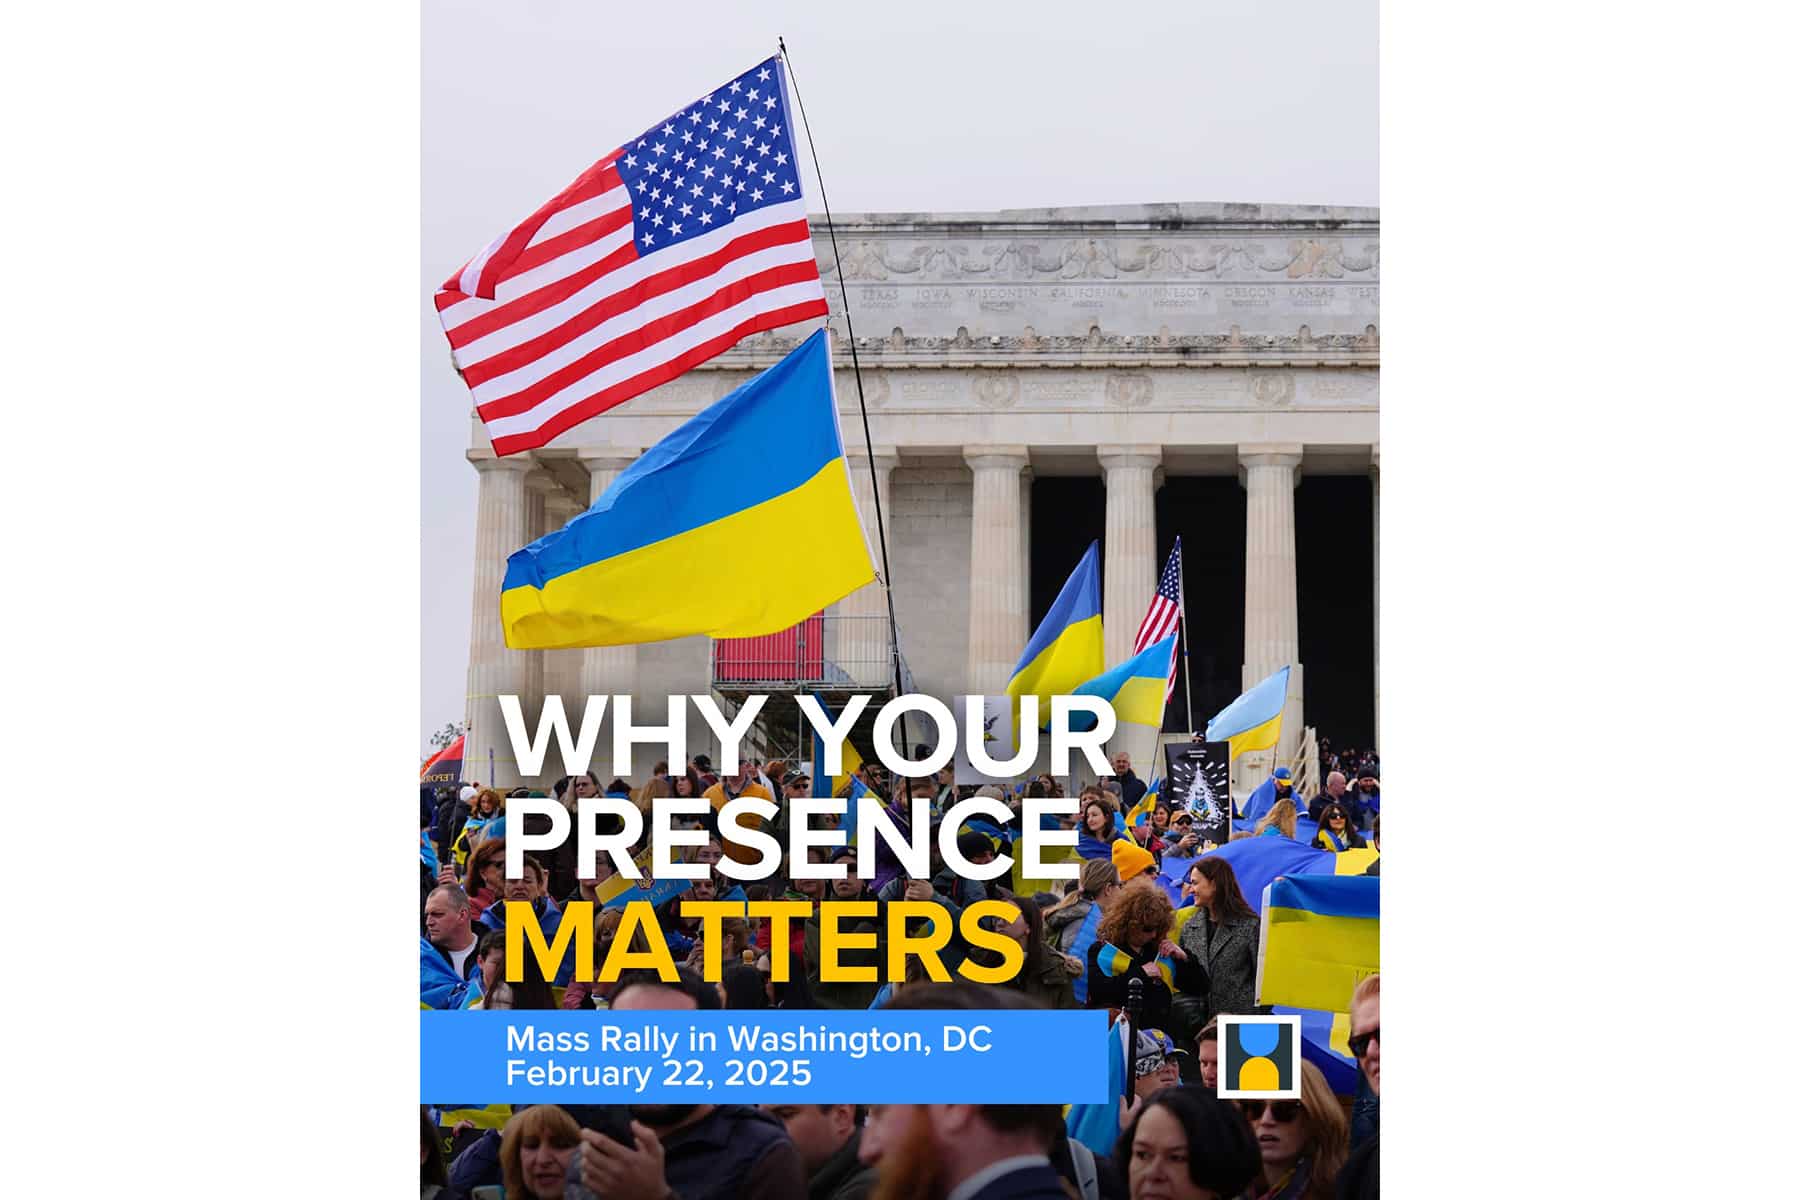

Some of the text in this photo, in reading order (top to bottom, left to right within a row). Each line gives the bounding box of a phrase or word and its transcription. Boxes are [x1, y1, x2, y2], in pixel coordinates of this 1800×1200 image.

[860, 289, 899, 300] TEXAS
[917, 289, 952, 300] IOWA
[967, 289, 1038, 299] WISCONSIN
[1050, 288, 1123, 299] CALIFORNIA
[1138, 287, 1210, 298] MINNESOTA
[1224, 287, 1276, 298] OREGON
[1288, 287, 1335, 298] KANSAS
